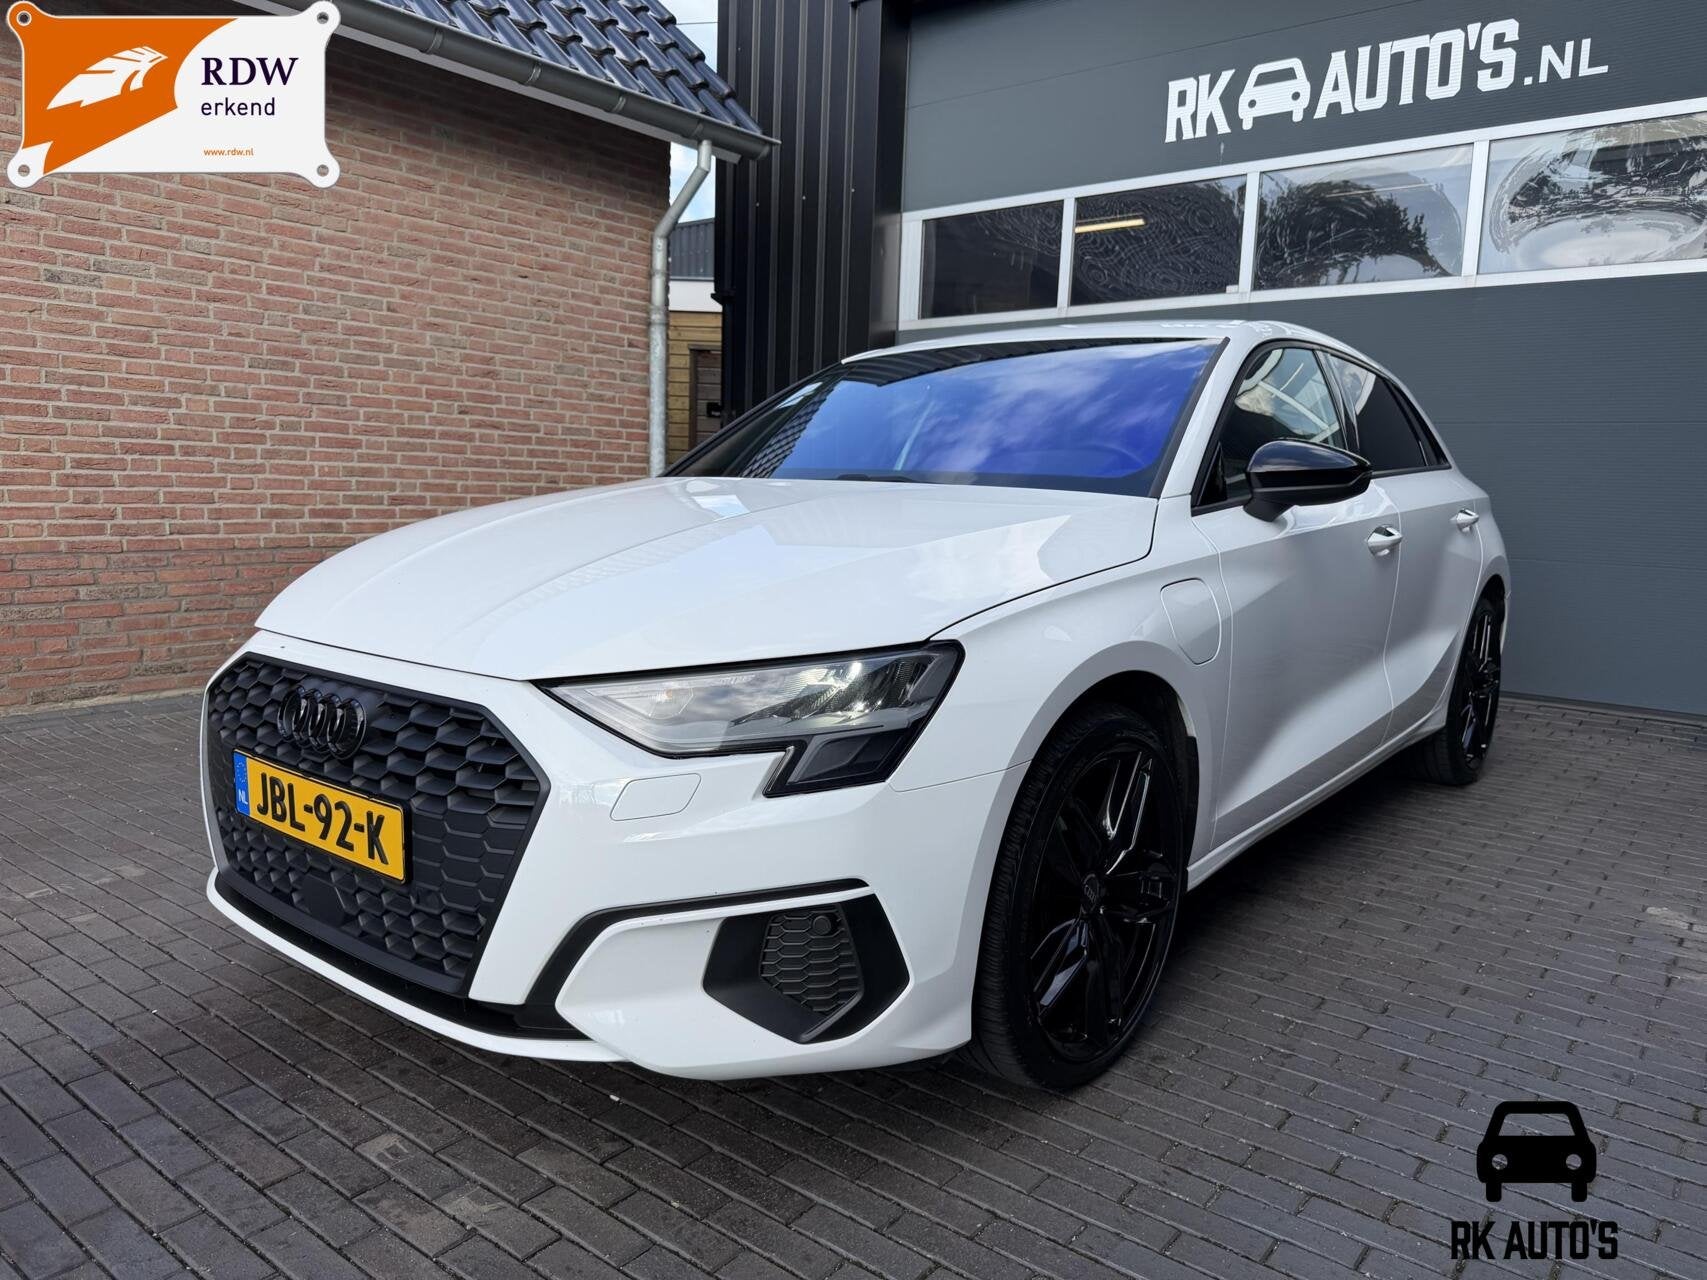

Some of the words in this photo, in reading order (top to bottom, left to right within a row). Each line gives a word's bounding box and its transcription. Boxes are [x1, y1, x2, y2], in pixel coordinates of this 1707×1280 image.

[1165, 69, 1236, 143] RK
[238, 790, 249, 805] NL
[257, 772, 389, 865] JBL-92-K
